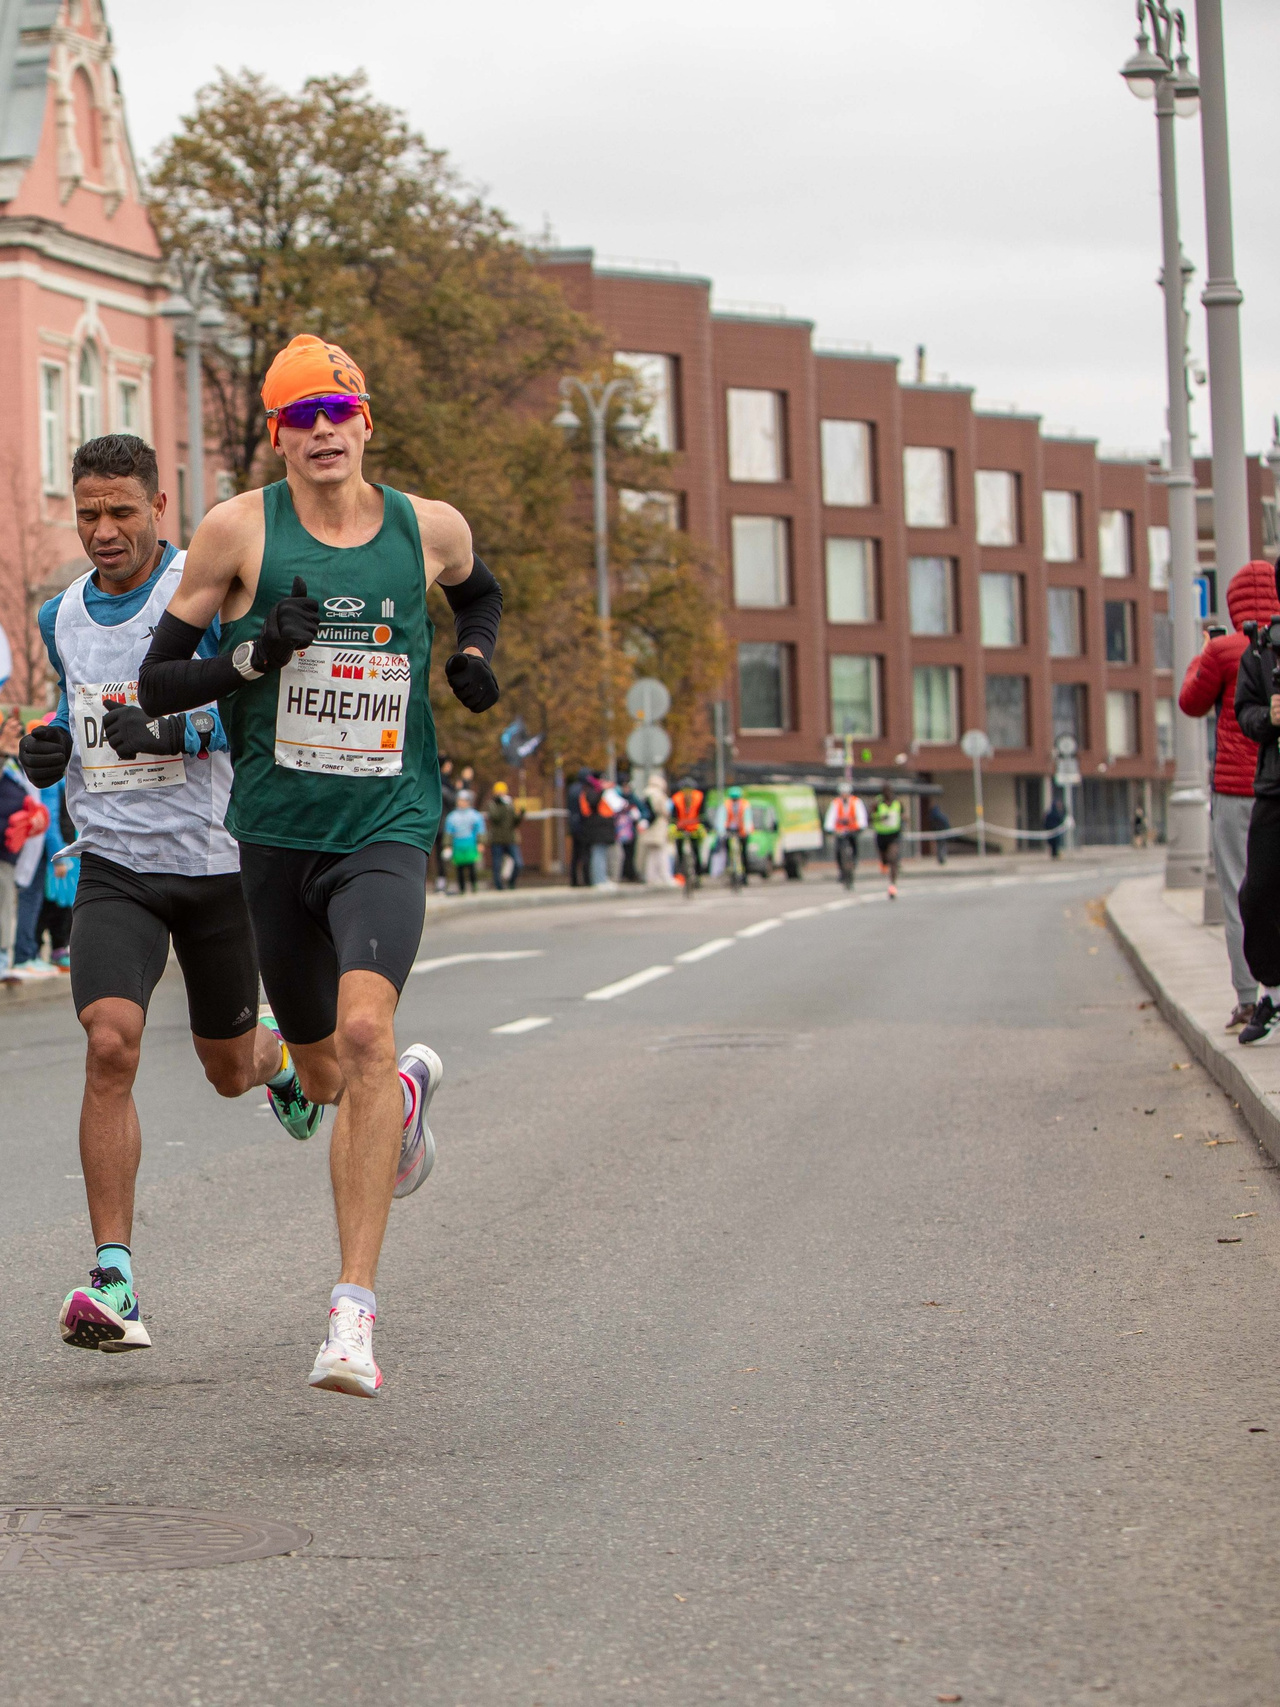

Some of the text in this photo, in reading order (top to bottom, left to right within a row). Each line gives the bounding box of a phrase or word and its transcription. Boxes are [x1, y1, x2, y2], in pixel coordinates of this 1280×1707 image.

[317, 628, 369, 640] Winline
[368, 656, 390, 667] 42,2
[287, 686, 402, 724] НЕДЕЛИН
[340, 732, 347, 742] 7
[321, 763, 344, 771] FONBET
